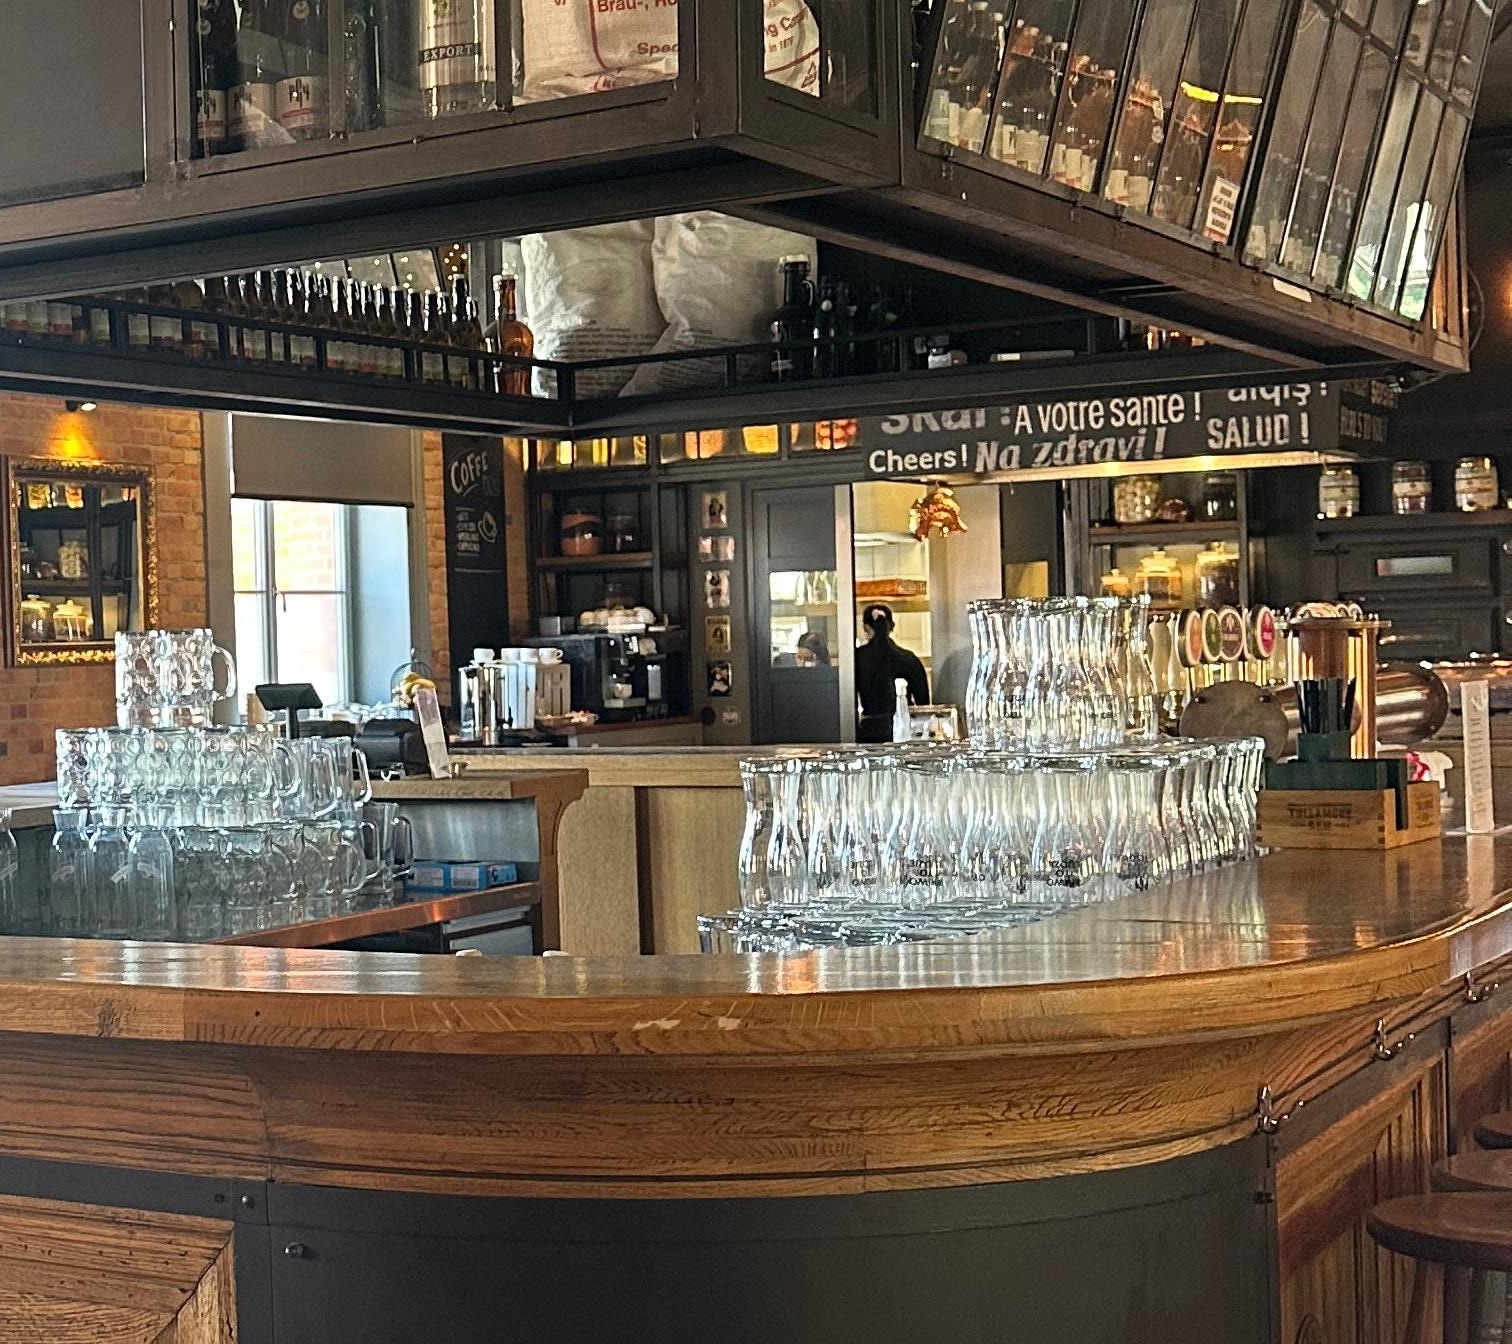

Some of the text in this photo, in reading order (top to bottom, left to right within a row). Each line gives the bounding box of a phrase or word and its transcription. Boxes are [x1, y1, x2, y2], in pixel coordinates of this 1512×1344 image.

[423, 44, 474, 62] EXPORT
[1038, 399, 1105, 433] votre
[1207, 413, 1290, 449] SALUD
[974, 440, 1021, 473] Na
